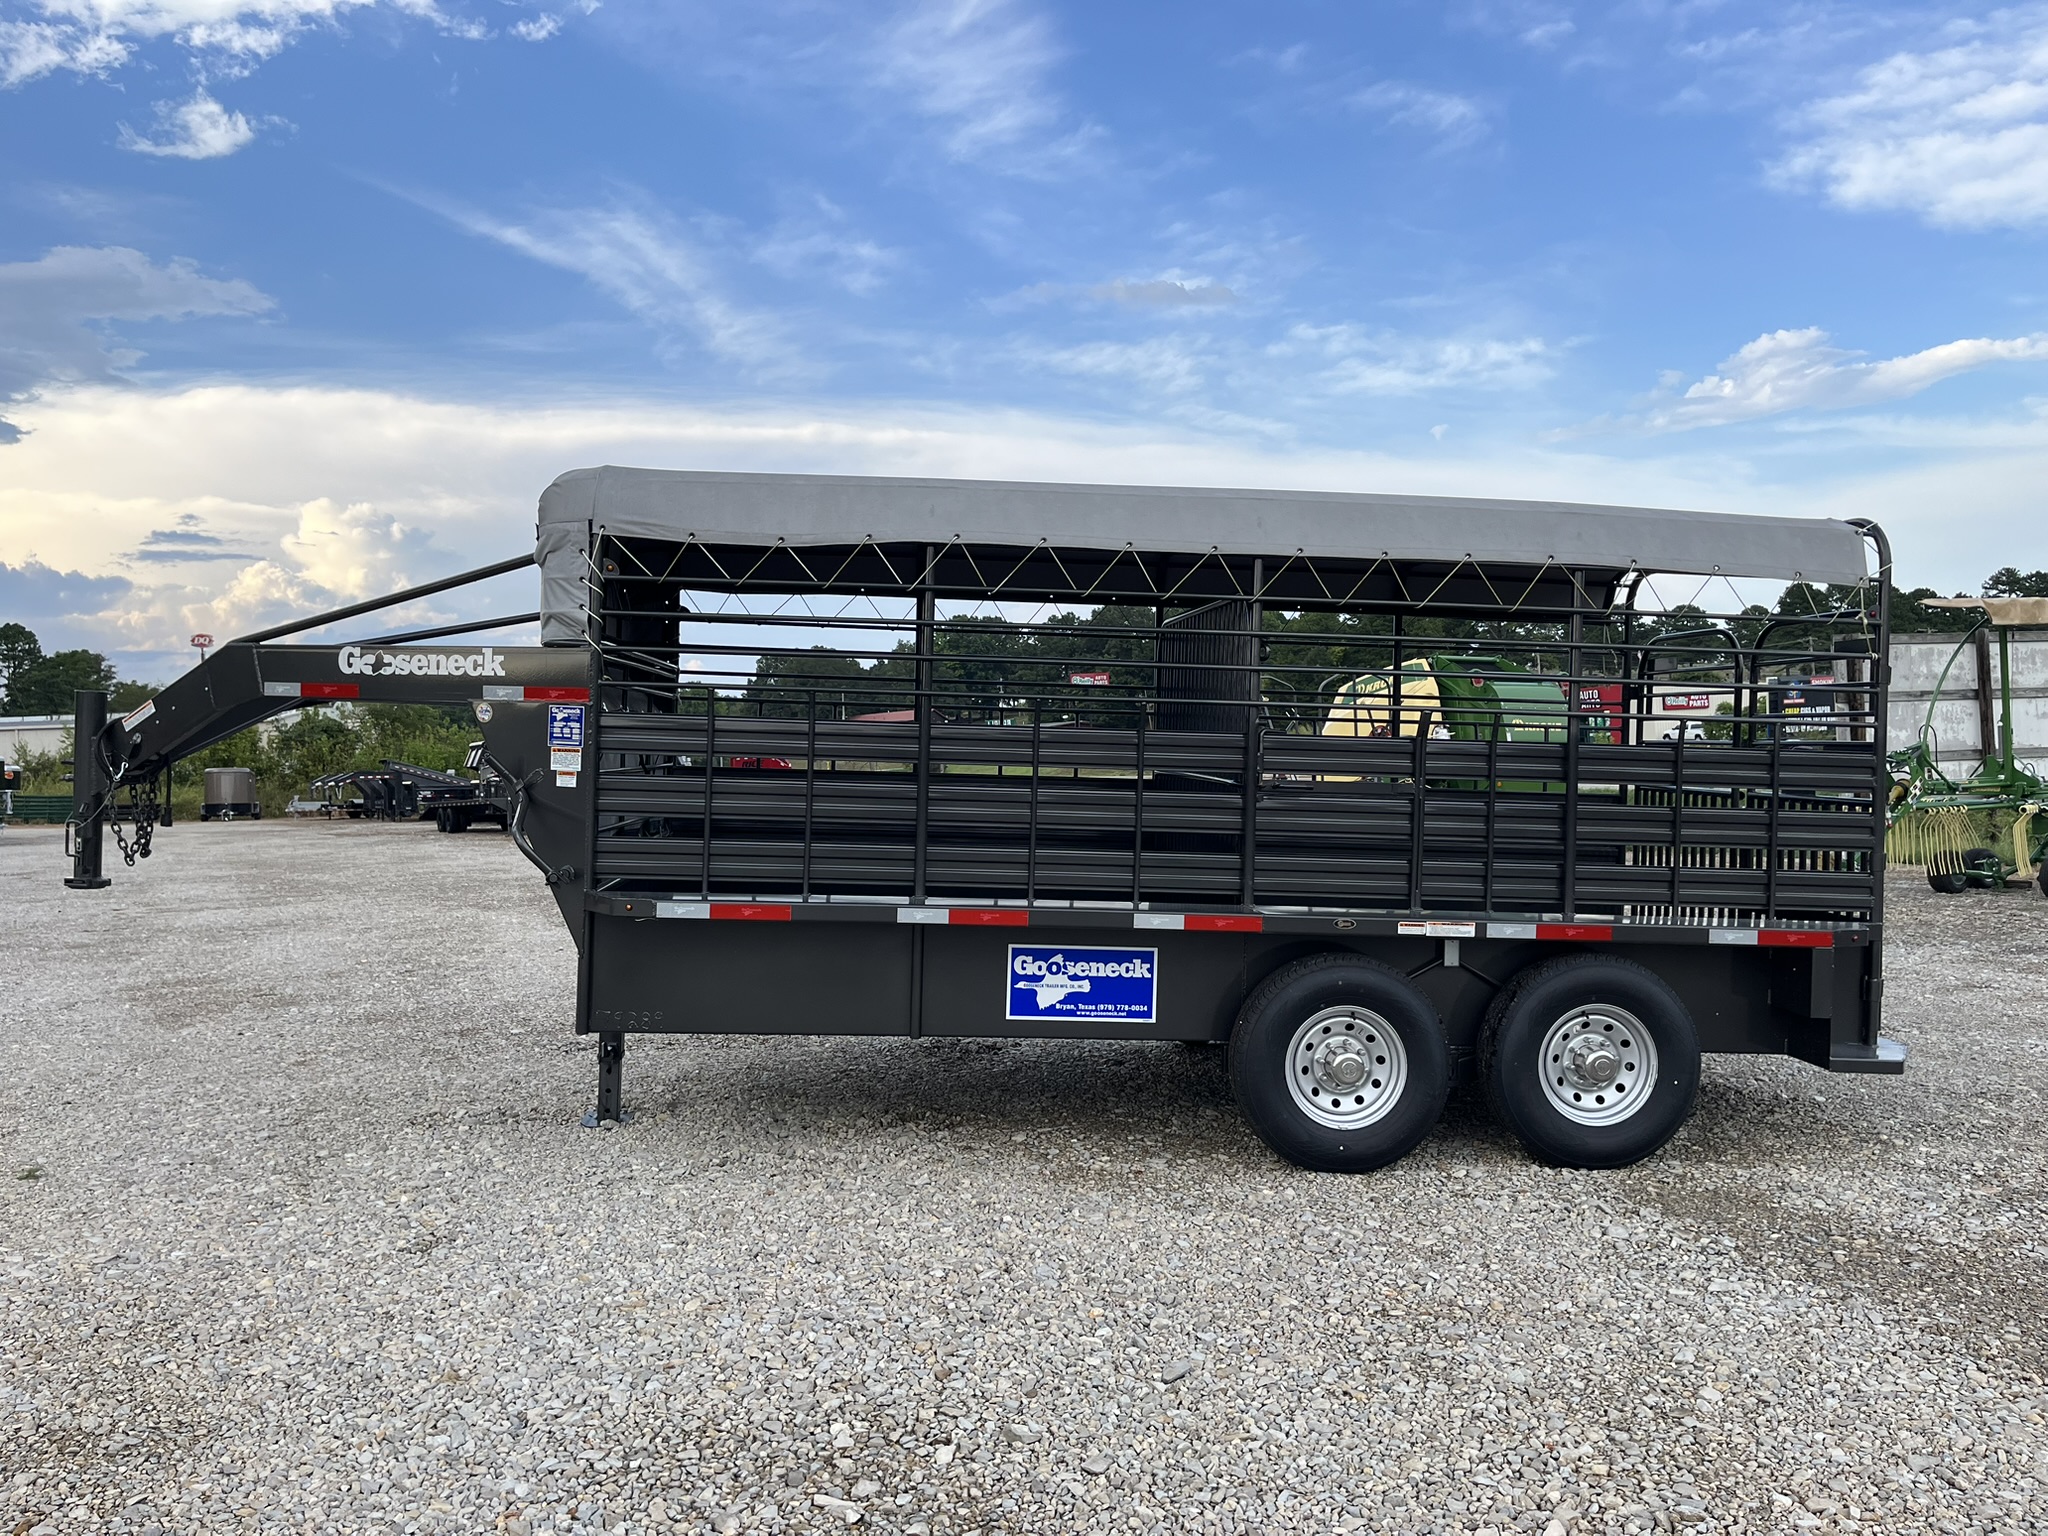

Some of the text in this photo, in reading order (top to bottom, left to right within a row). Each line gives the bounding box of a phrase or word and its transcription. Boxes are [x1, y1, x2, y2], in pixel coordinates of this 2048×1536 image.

[195, 636, 209, 644] DQ
[338, 646, 505, 677] Gooseneck
[1580, 690, 1599, 700] AUTO
[1013, 955, 1152, 978] Gooseneck
[1055, 1003, 1077, 1011] Bryan,
[1097, 1004, 1115, 1012] (979)
[1116, 1004, 1148, 1012] 778-0034
